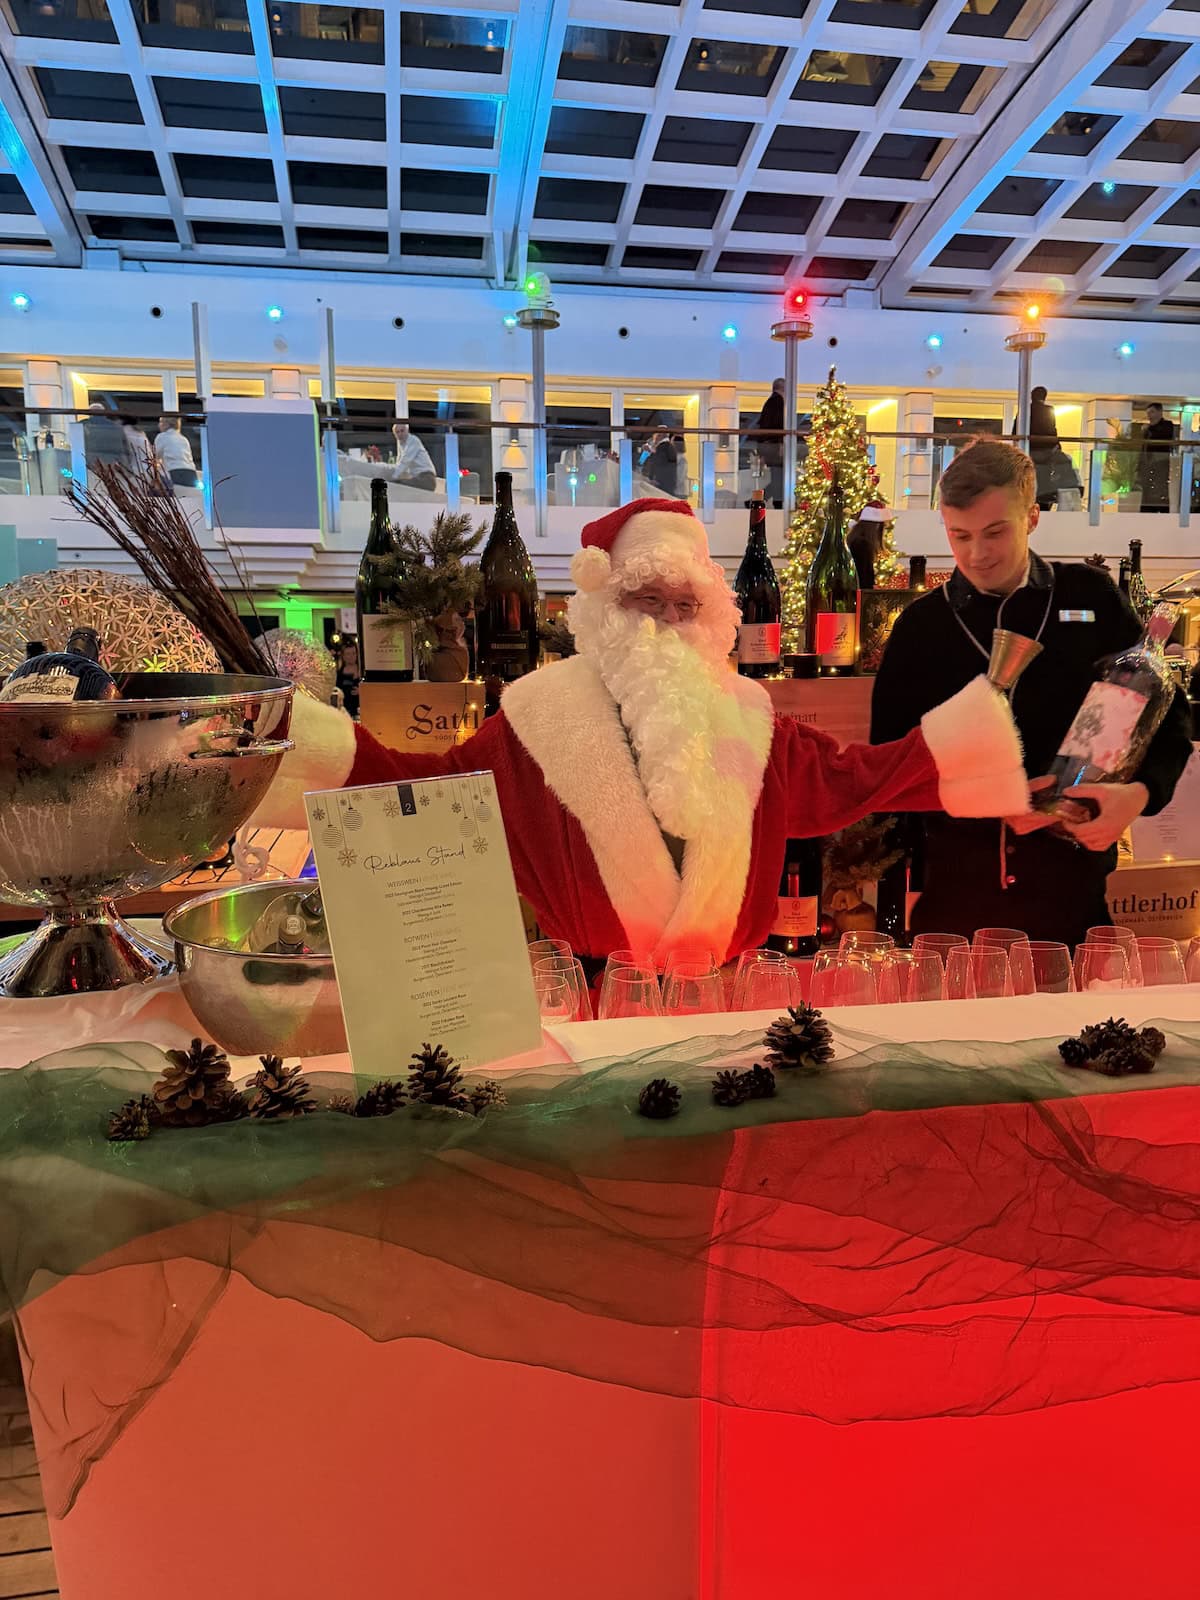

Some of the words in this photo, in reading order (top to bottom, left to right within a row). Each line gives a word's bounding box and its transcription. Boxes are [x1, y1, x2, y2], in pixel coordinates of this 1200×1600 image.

[406, 704, 480, 740] Sattl
[404, 802, 412, 813] 2
[363, 853, 421, 875] Reblaus
[426, 842, 466, 866] Stand
[1112, 889, 1199, 914] ttlerhof
